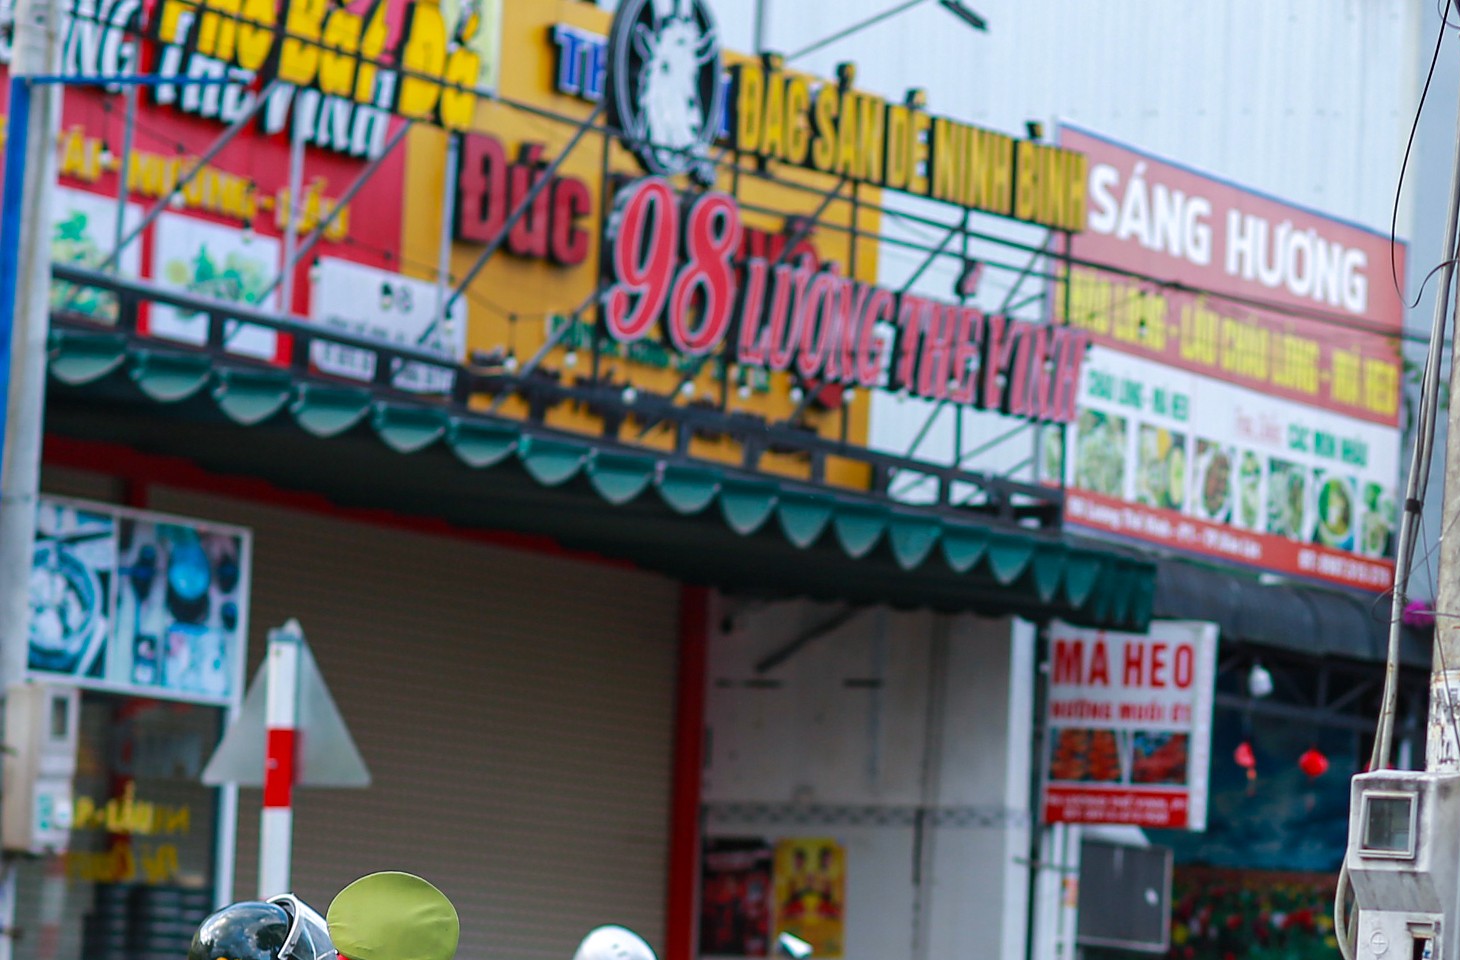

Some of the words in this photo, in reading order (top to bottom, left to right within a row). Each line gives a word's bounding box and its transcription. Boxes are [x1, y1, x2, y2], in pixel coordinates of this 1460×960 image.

[604, 178, 742, 356] 98
[1088, 160, 1213, 266] SÁNG
[1225, 208, 1368, 313] HƯƠNG
[1053, 629, 1110, 685] MÁ
[1123, 641, 1194, 689] HEO
